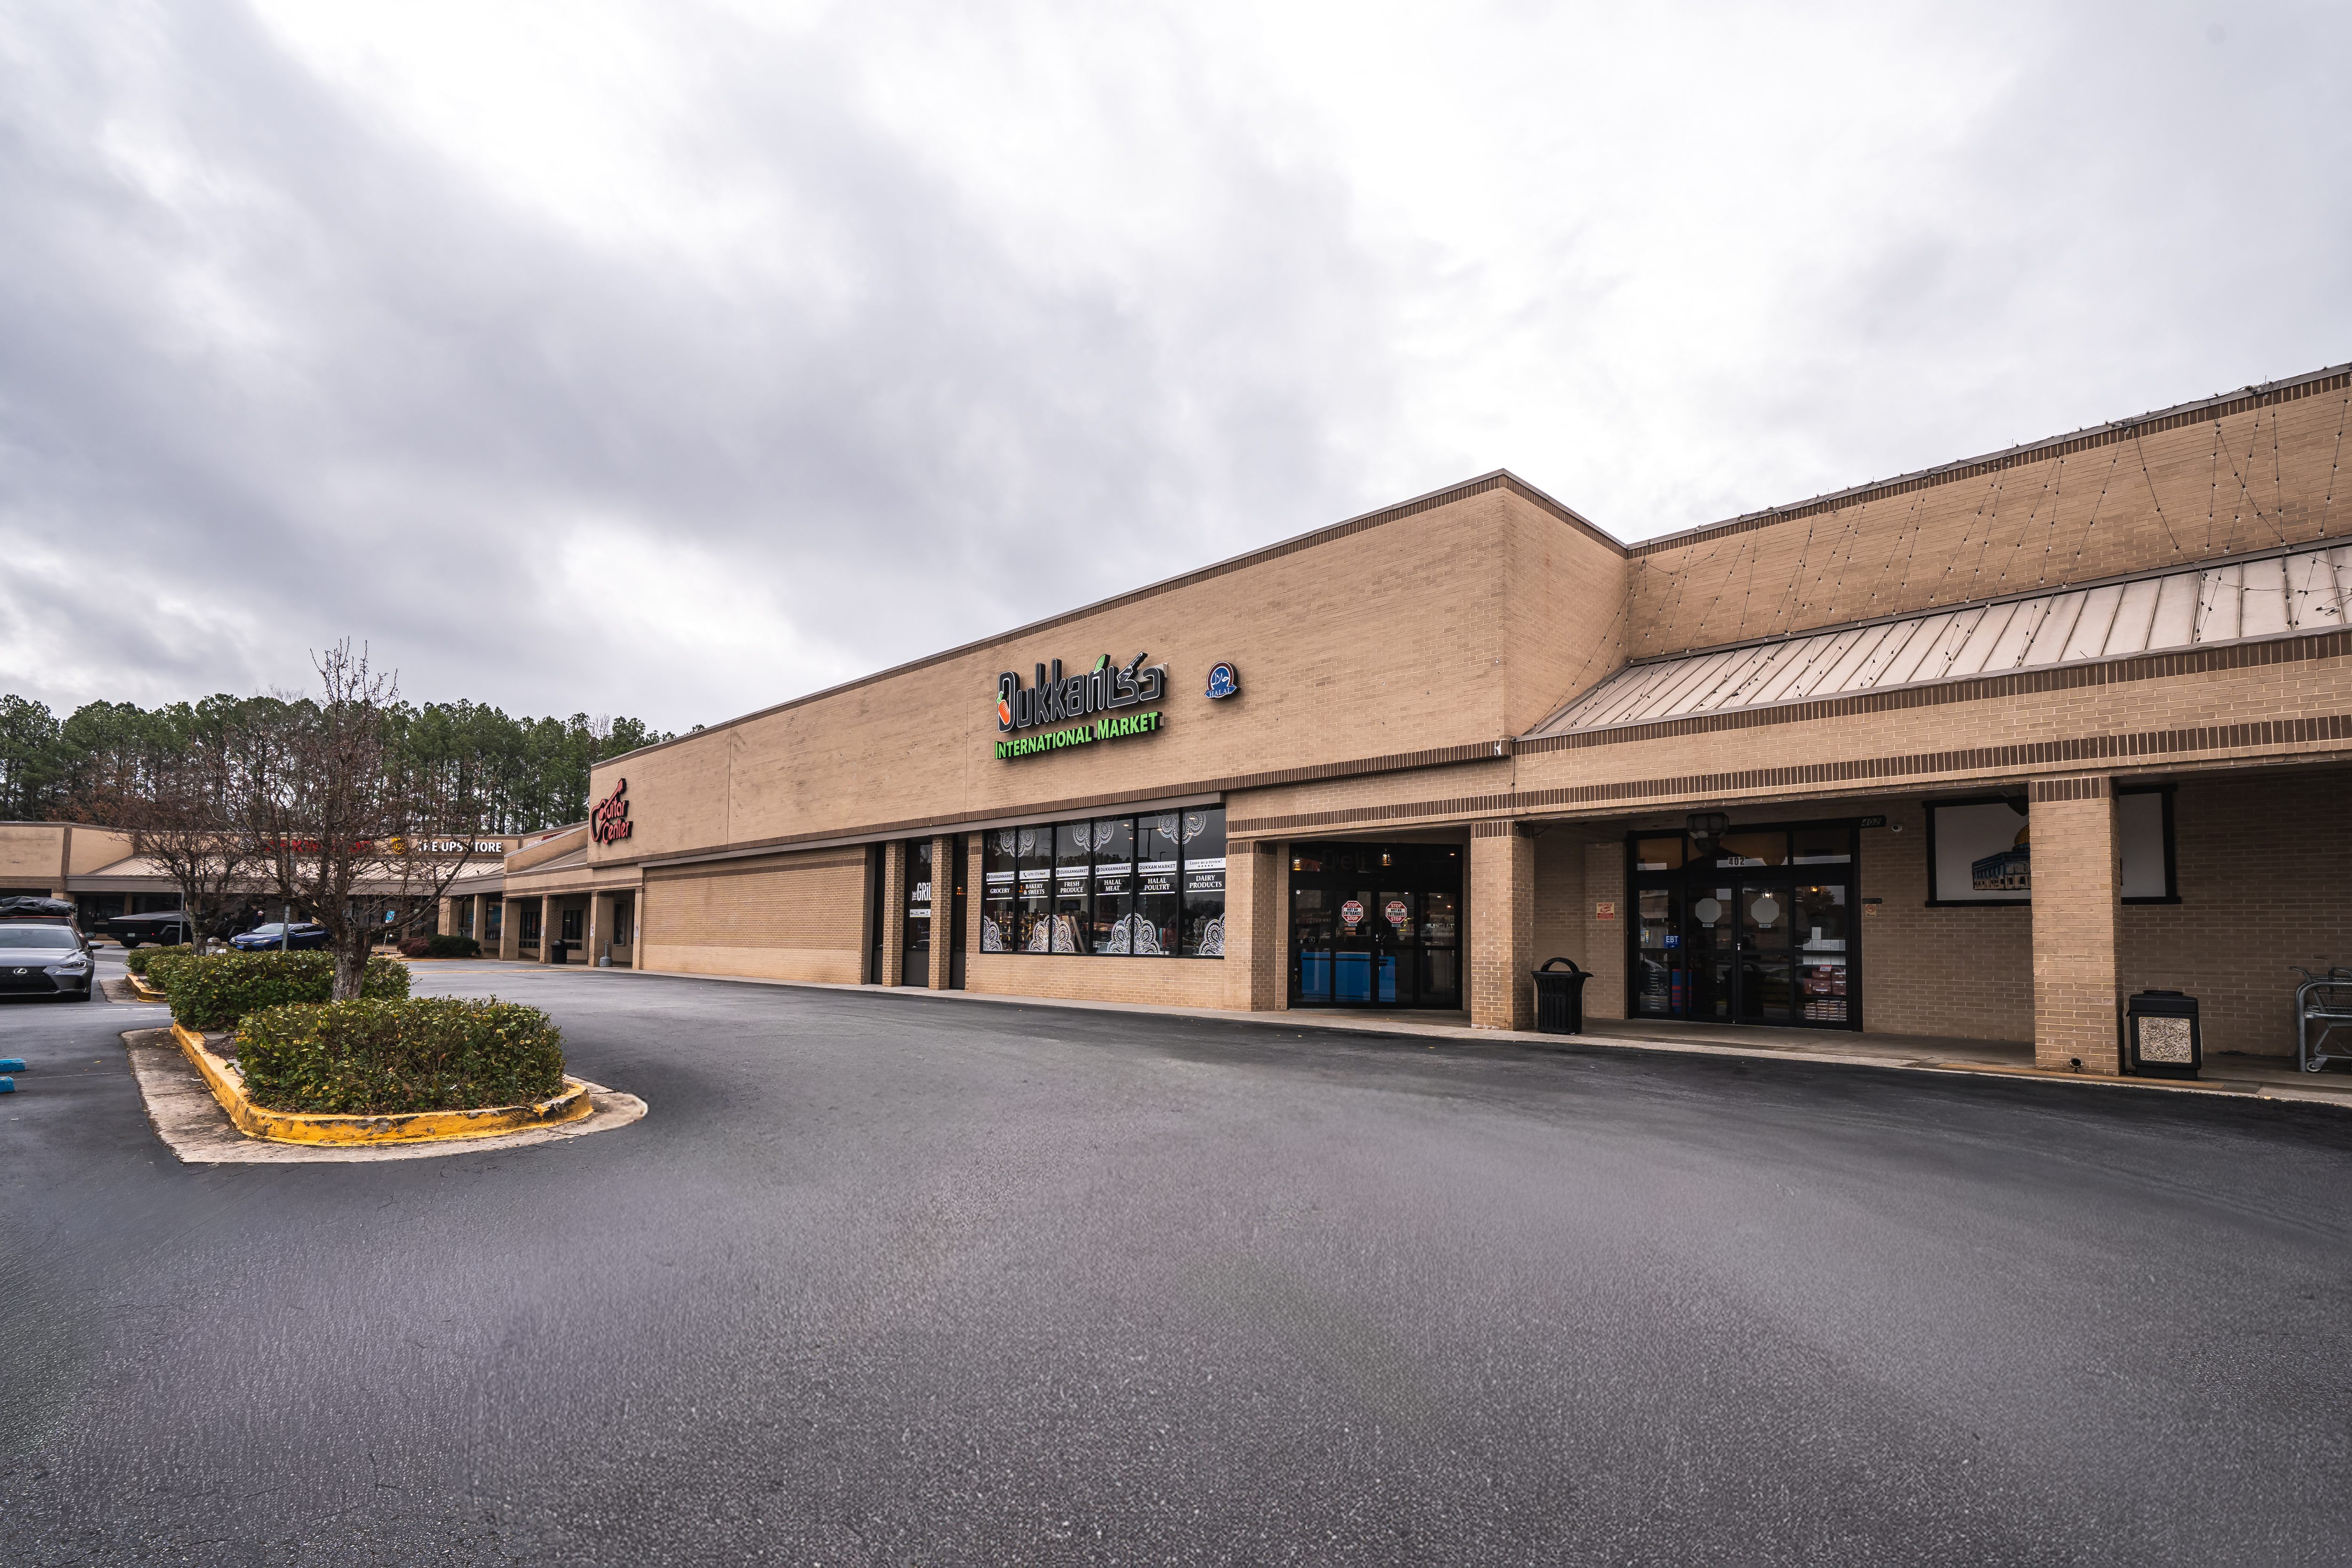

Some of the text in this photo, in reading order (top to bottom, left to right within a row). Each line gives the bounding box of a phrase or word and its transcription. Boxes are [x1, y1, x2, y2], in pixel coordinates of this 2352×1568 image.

[1211, 672, 1230, 686] حلال
[997, 654, 1106, 733] Dukkan
[1209, 687, 1232, 697] HALAL
[994, 711, 1158, 760] INTERNATIONAL MARKET
[441, 842, 463, 852] UPS
[467, 842, 502, 852] TORE
[1728, 857, 1745, 866] 402
